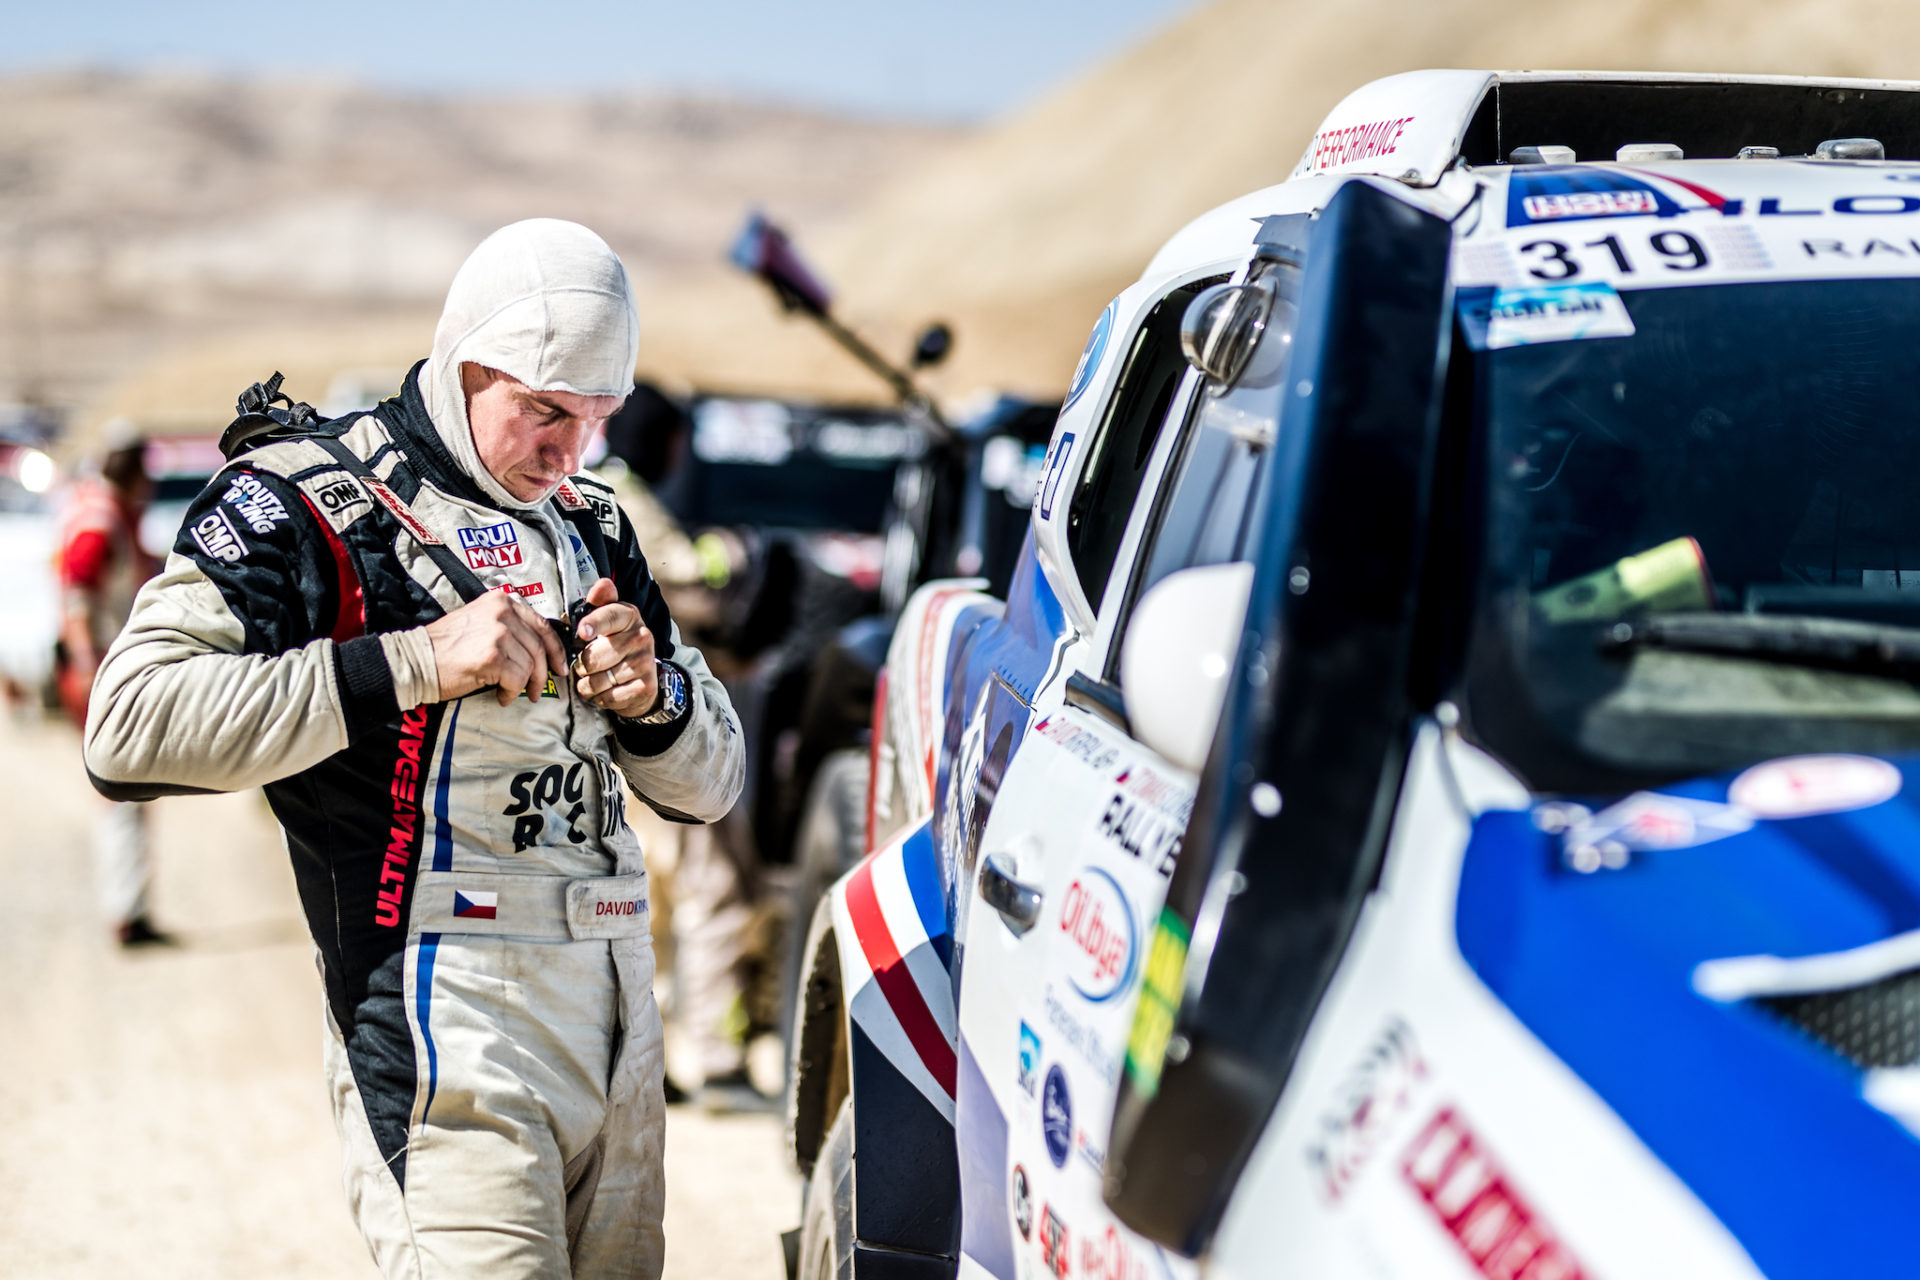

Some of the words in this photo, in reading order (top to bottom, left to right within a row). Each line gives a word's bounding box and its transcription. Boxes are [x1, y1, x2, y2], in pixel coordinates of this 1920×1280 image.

[1313, 116, 1415, 170] PERFORMANCE
[1519, 230, 1711, 280] 319
[230, 474, 290, 521] SOUTH
[320, 483, 361, 509] OMP
[197, 514, 242, 562] OMP
[460, 523, 515, 548] LIQUI
[468, 544, 518, 568] MOLY
